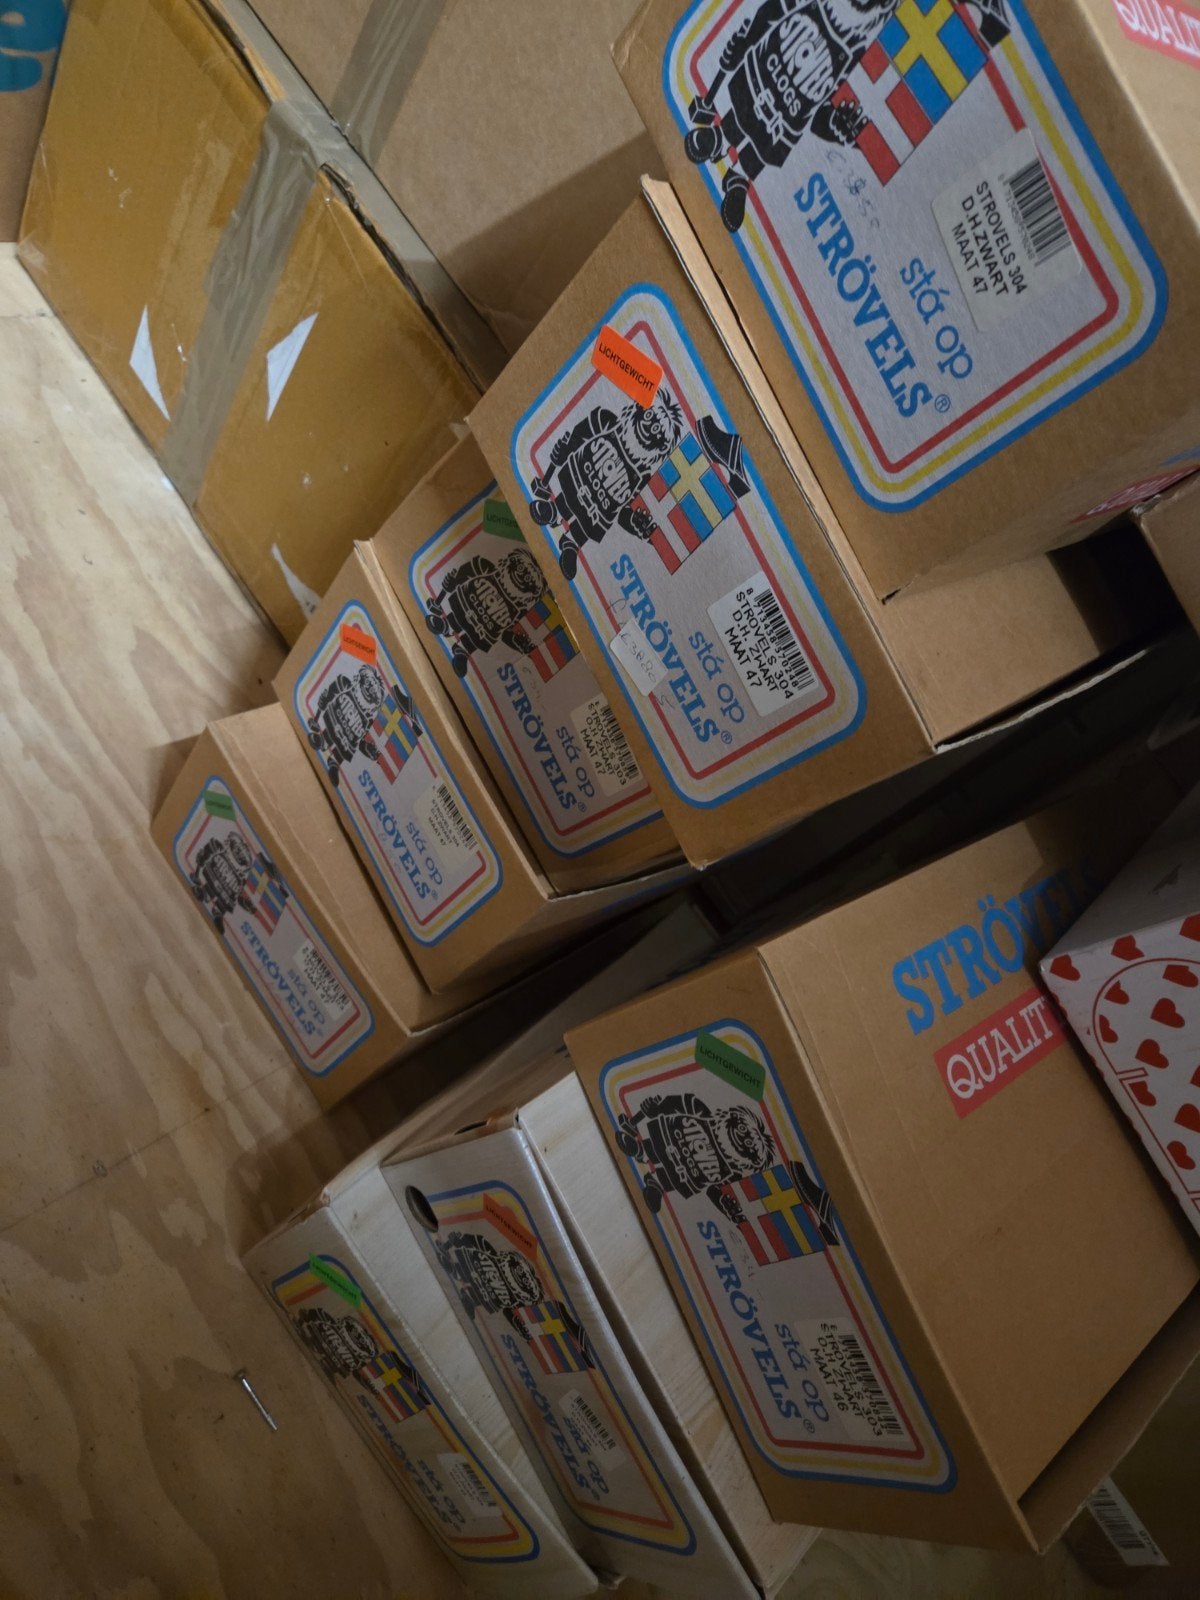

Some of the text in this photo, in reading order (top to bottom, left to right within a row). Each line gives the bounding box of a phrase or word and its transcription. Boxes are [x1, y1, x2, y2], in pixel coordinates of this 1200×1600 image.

[761, 52, 806, 117] CLOGS
[951, 222, 988, 295] MAAT 47
[960, 196, 1009, 297] D.H.ZWART
[974, 181, 1028, 294] STROVELS 304
[597, 342, 654, 391] LICHTGEWICHT
[927, 325, 975, 383] op
[580, 460, 613, 510] CLOGS
[468, 591, 494, 631] CLOGS
[724, 626, 762, 689] MAAT 47
[734, 590, 794, 699] STROVELS 304
[748, 643, 779, 693] ZWART
[714, 681, 745, 727] op
[580, 727, 606, 776] MAAT 47
[586, 702, 627, 785] STROVELS 303
[595, 738, 615, 776] ZWART
[573, 766, 596, 799] op
[423, 856, 443, 885] op
[305, 999, 325, 1025] op
[699, 1045, 761, 1087] LICHTGEWICHT
[946, 996, 1055, 1099] QUALIT
[670, 1127, 702, 1178] CLOGS
[799, 1377, 831, 1423] op
[809, 1347, 849, 1412] MAAT 46
[819, 1322, 882, 1436] STROVELS 303
[832, 1367, 864, 1418] ZWART
[586, 1460, 610, 1495] op
